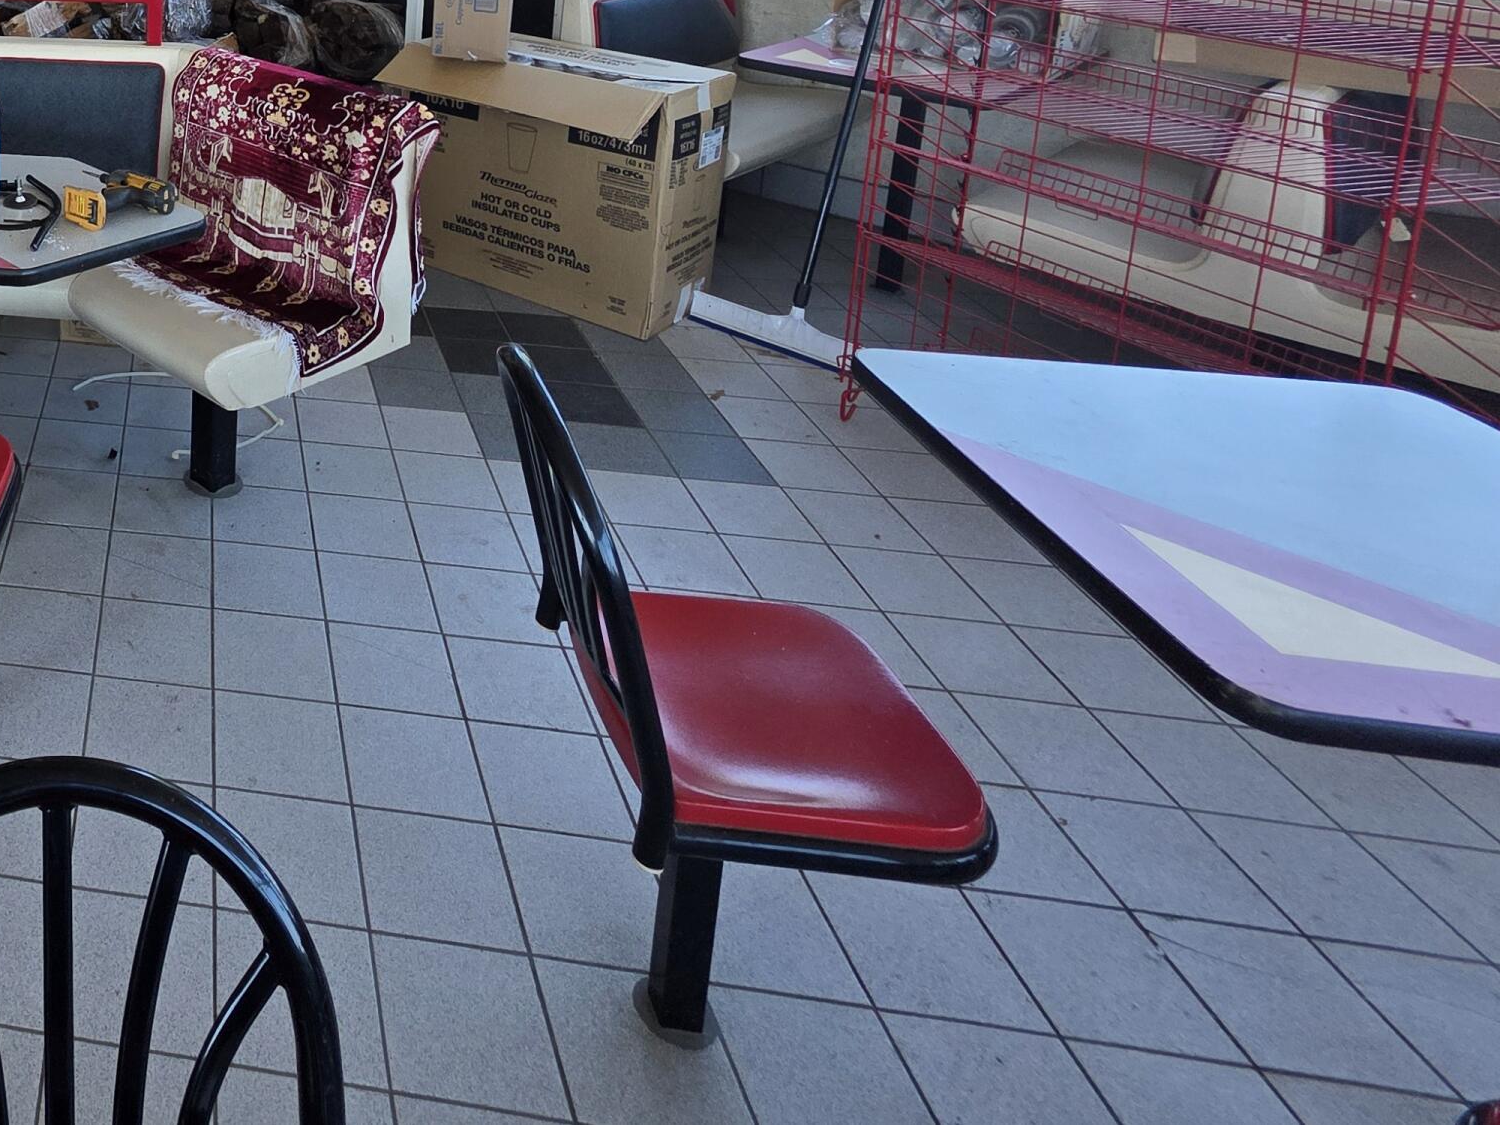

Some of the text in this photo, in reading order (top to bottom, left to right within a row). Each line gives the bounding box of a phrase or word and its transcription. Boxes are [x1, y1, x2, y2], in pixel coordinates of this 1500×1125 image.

[606, 166, 621, 174] NO
[471, 200, 561, 232] INSULATED CUPS
[481, 192, 552, 219] HOT OR COLD
[442, 221, 485, 241] BEBIDAS
[487, 233, 544, 258] CALIENTES
[547, 252, 555, 262] O
[558, 255, 591, 273] FRÍAS
[455, 215, 576, 258] VASOS TÉRMICOS PARA
